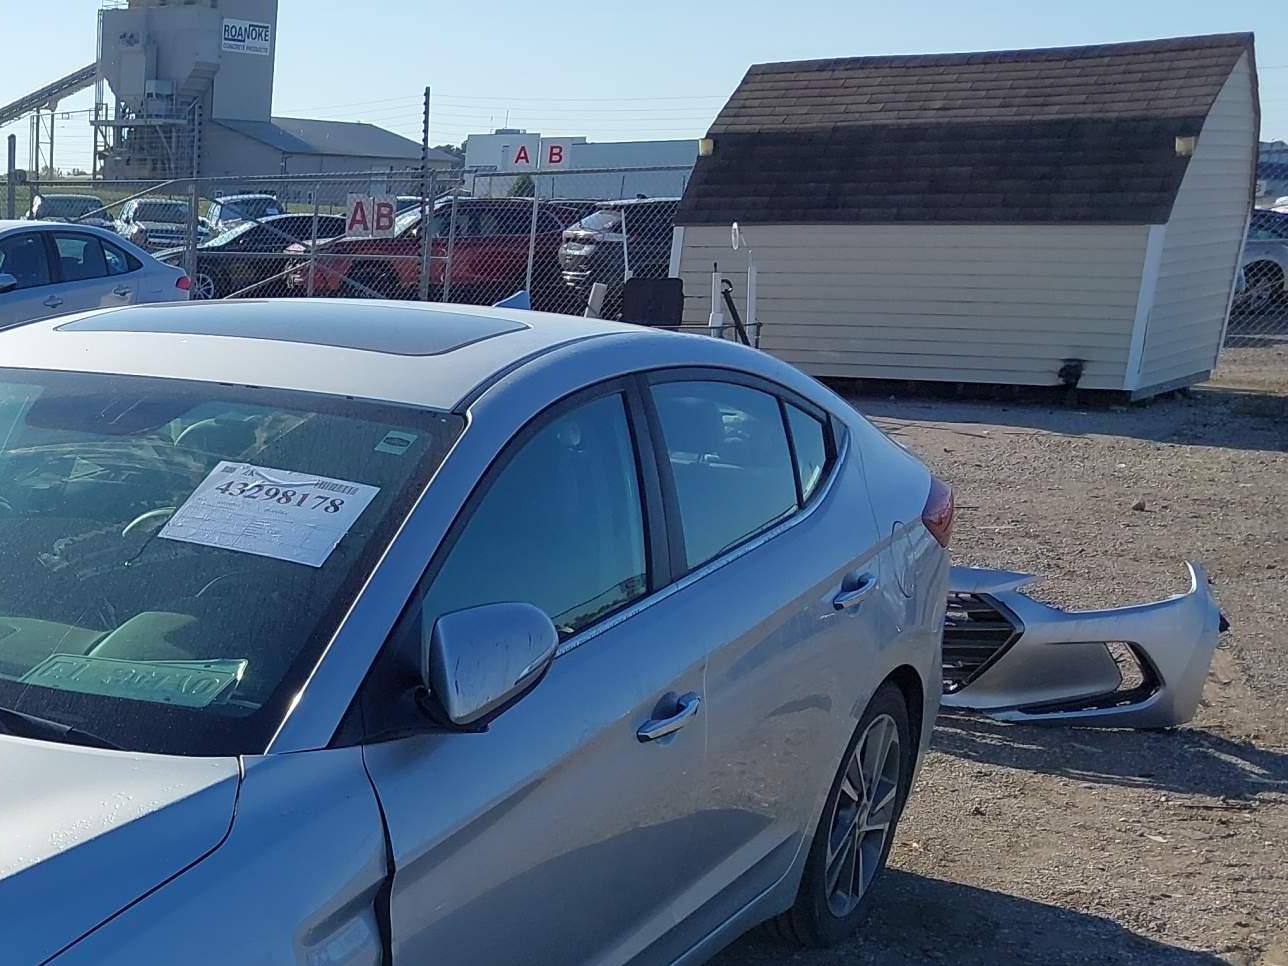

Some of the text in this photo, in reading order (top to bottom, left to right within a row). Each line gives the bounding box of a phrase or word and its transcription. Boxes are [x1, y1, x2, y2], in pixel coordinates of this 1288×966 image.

[223, 23, 270, 42] ROANOKE
[514, 145, 563, 164] A B
[215, 480, 345, 514] 43298178
